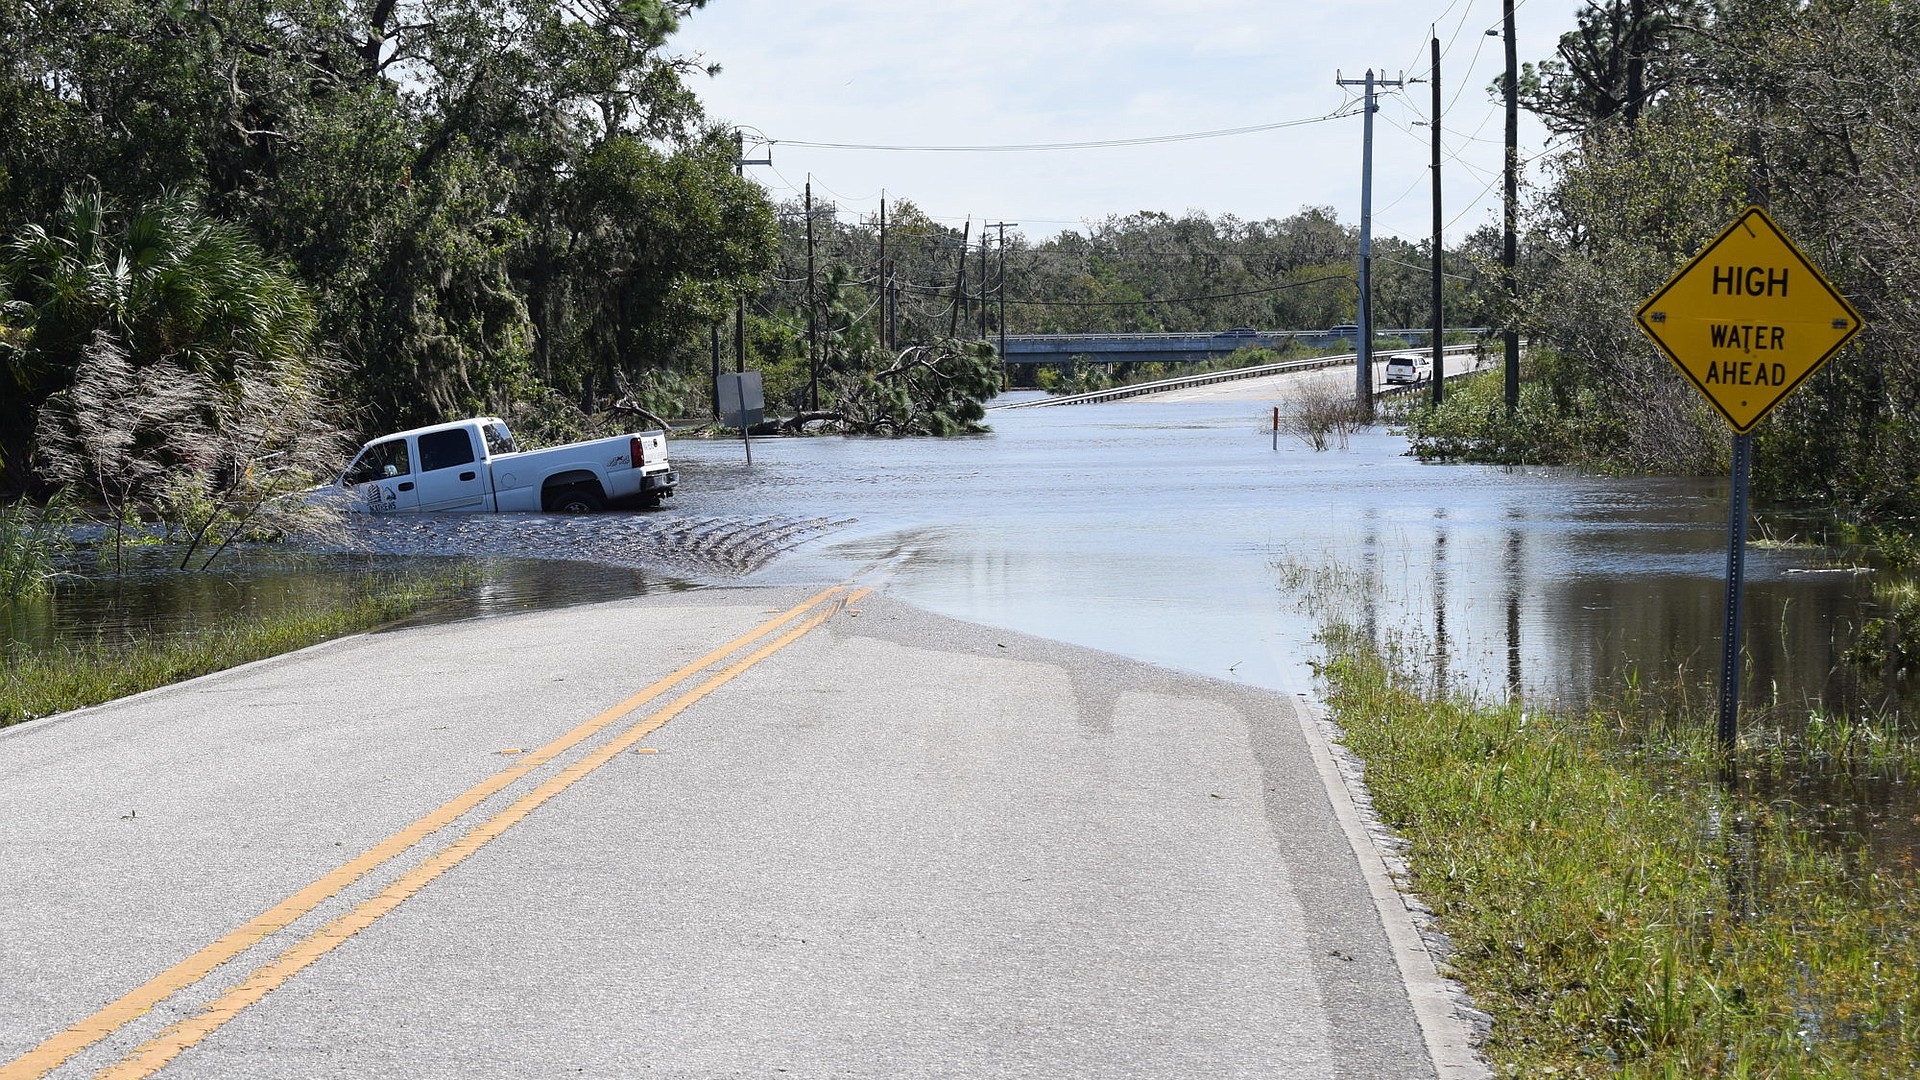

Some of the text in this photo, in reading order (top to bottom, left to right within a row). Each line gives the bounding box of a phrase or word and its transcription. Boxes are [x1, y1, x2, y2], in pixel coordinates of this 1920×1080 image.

[1712, 266, 1788, 297] HIGH
[1710, 324, 1785, 350] WATER
[1705, 361, 1786, 387] AHEAD
